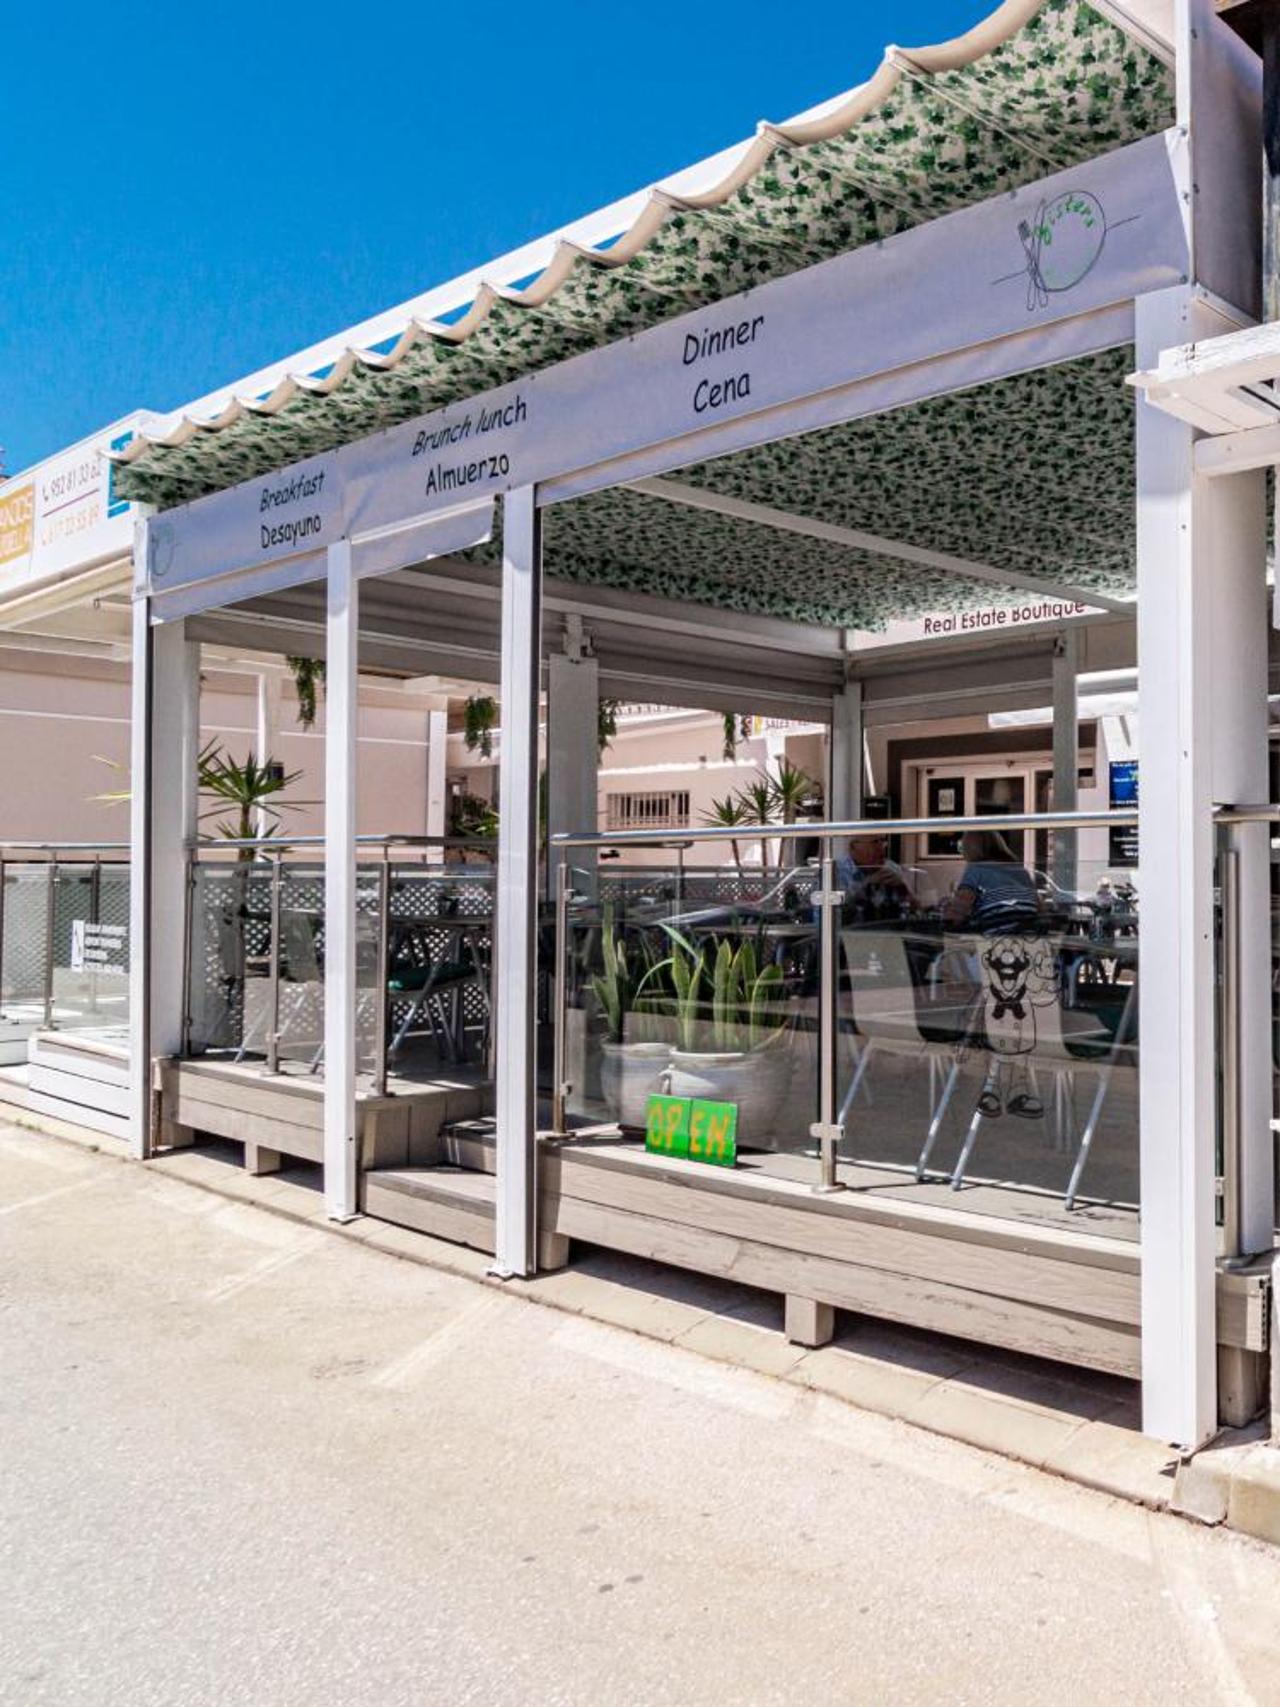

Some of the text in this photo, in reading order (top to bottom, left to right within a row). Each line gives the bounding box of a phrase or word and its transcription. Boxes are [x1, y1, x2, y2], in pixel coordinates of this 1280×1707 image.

[683, 316, 764, 366] Dinner
[693, 373, 750, 413] Cena
[412, 396, 527, 456] Brunch lunch
[260, 470, 325, 512] Breakfast
[426, 454, 509, 495] Almuerzo
[261, 513, 321, 549] Desayuno
[924, 600, 1086, 633] Real Estate Boutique
[650, 1103, 730, 1158] OPEN
